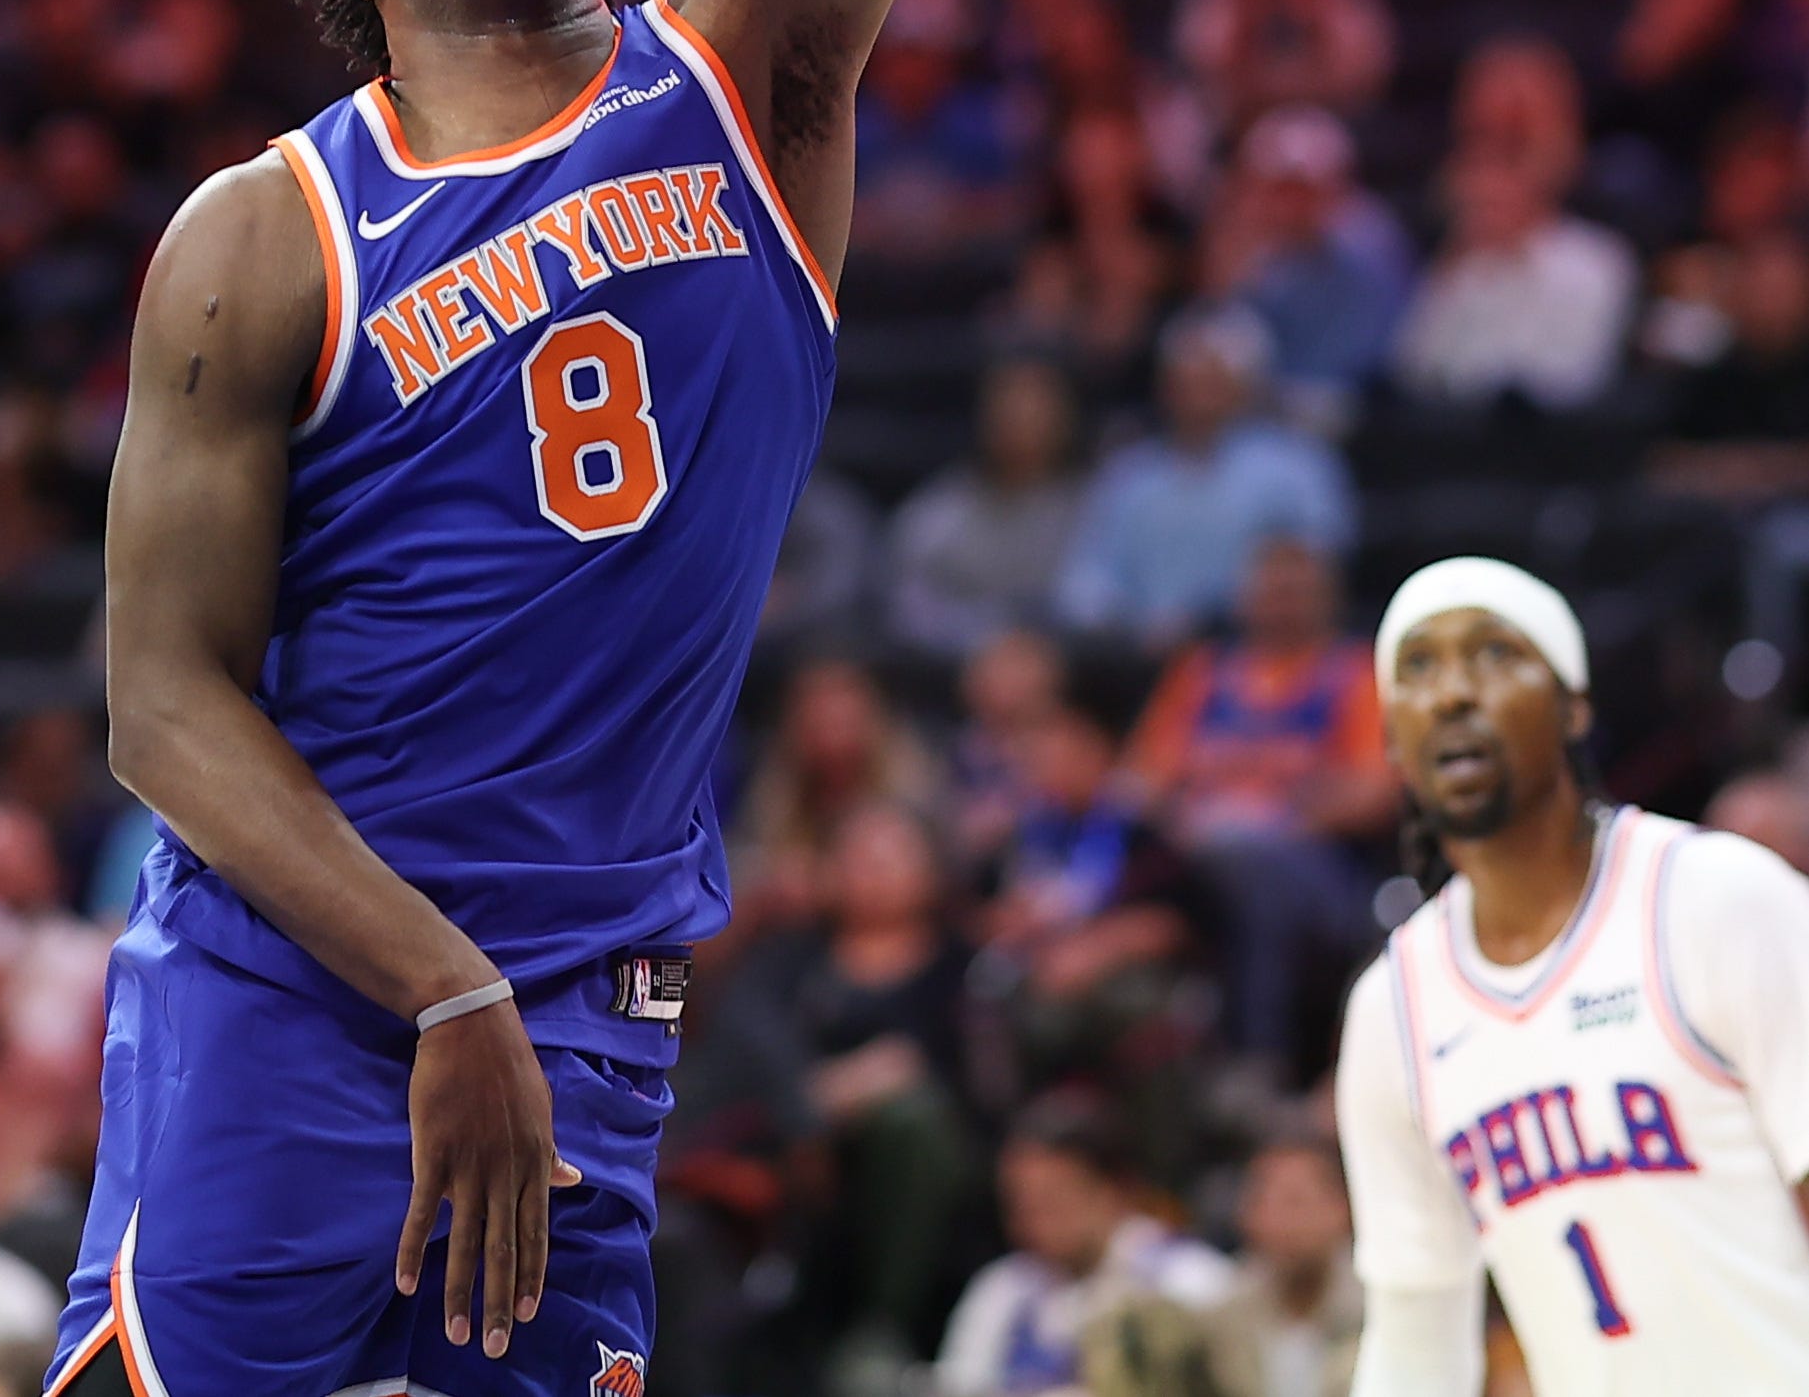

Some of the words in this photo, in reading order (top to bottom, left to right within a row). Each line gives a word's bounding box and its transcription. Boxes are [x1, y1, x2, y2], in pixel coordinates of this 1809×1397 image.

[584, 100, 622, 130] abu
[621, 68, 681, 106] dhabi
[362, 221, 551, 408] NEW
[532, 162, 750, 290] YORK
[521, 311, 669, 543] 8
[1442, 1081, 1700, 1234] PHILA
[1564, 1219, 1632, 1338] 1
